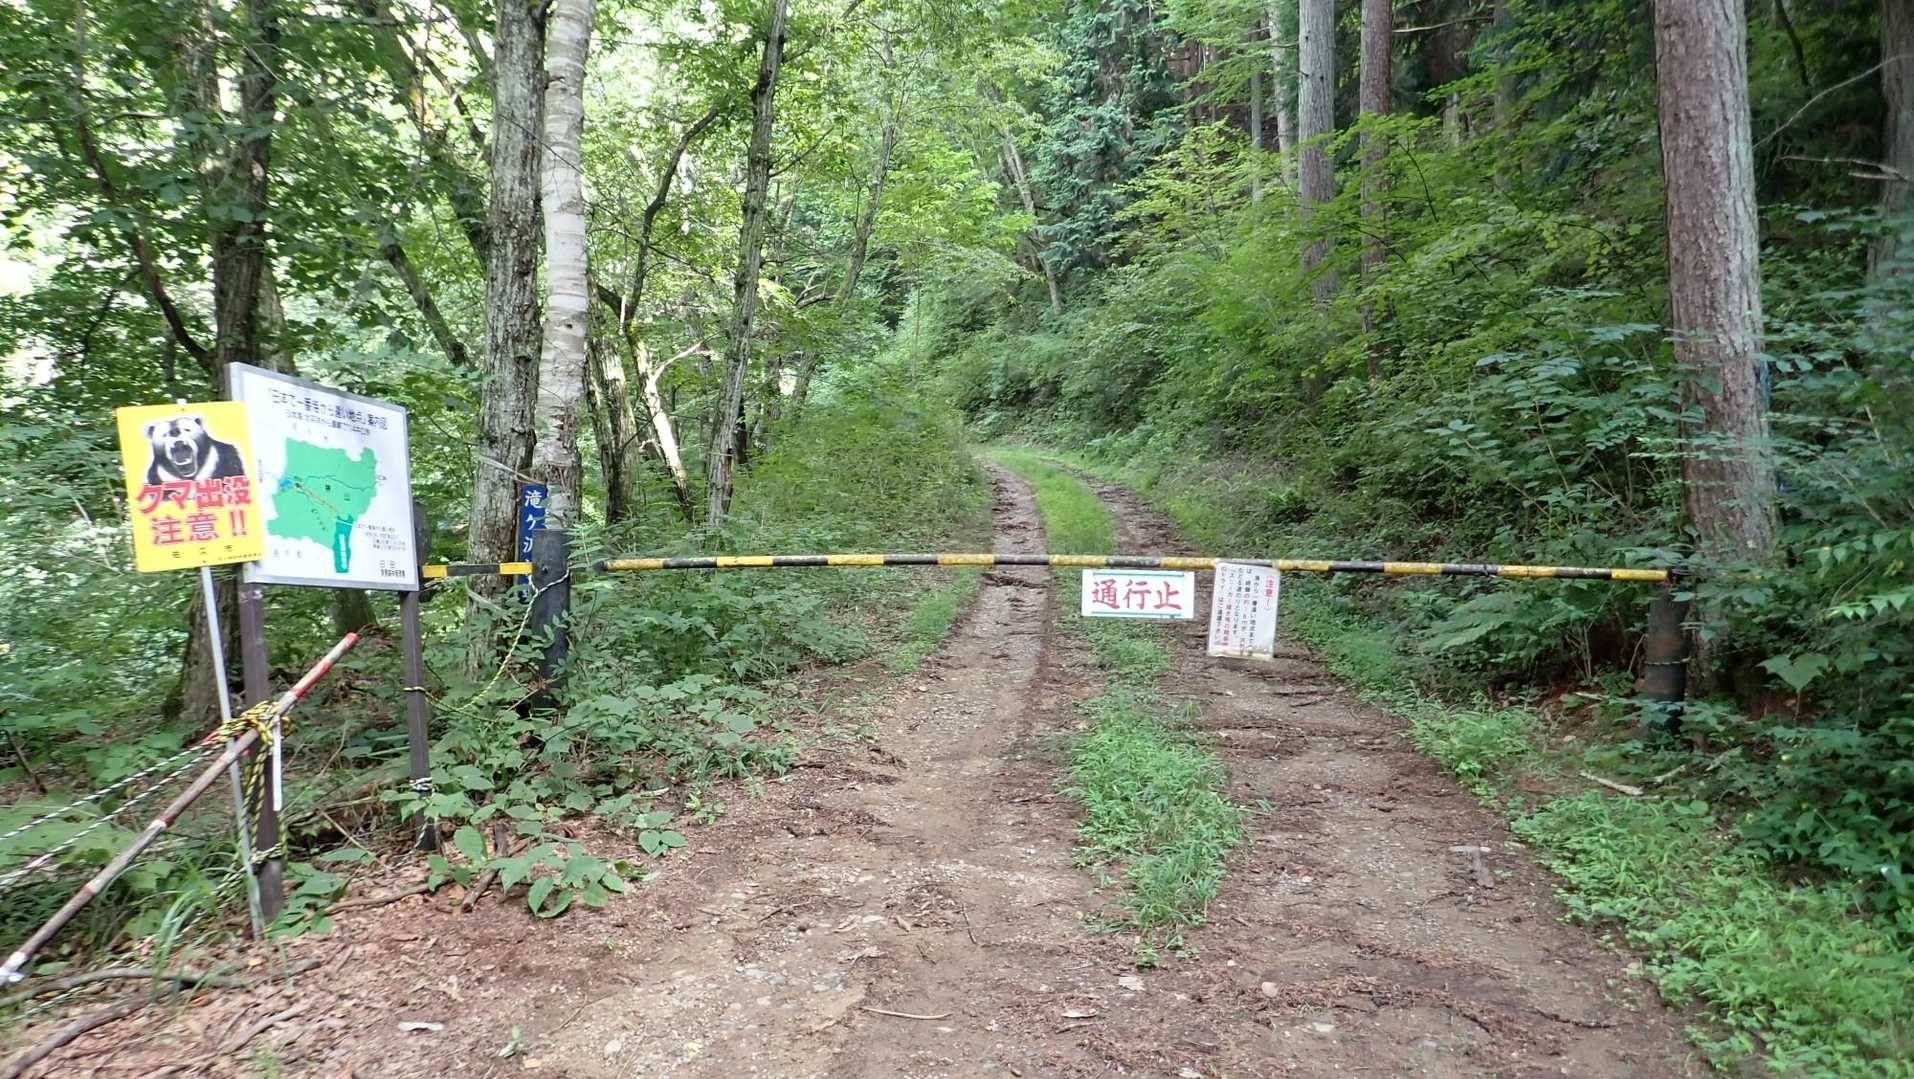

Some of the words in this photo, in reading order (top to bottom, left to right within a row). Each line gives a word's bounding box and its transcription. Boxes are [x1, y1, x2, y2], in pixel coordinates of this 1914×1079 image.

[136, 475, 252, 514] クマ出没
[1091, 579, 1183, 610] 通行止
